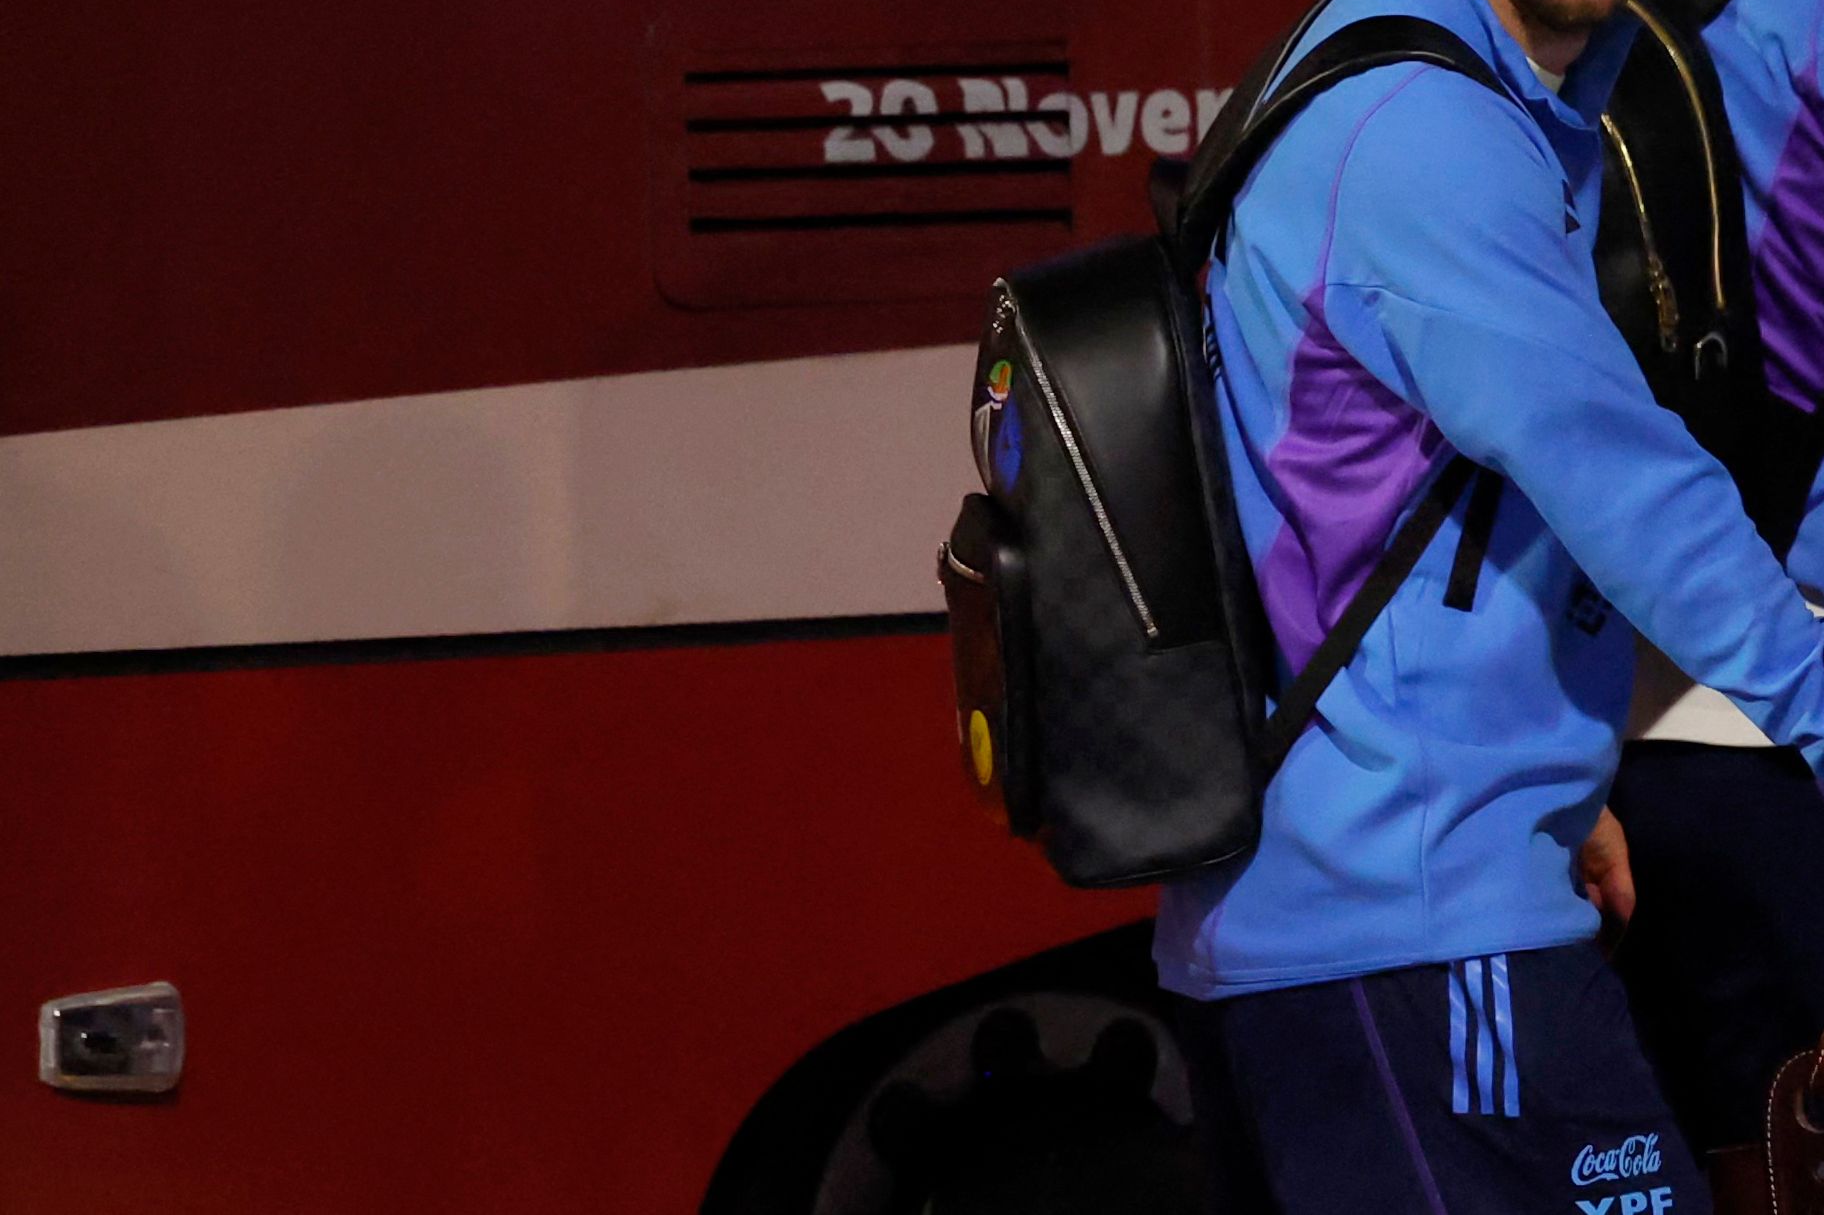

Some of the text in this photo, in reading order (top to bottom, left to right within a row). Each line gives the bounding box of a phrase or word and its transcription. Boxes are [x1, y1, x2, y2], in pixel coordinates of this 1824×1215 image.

[820, 78, 938, 162] 20
[1571, 1133, 1662, 1186] Coca-Cola
[1574, 1186, 1674, 1215] YPF
